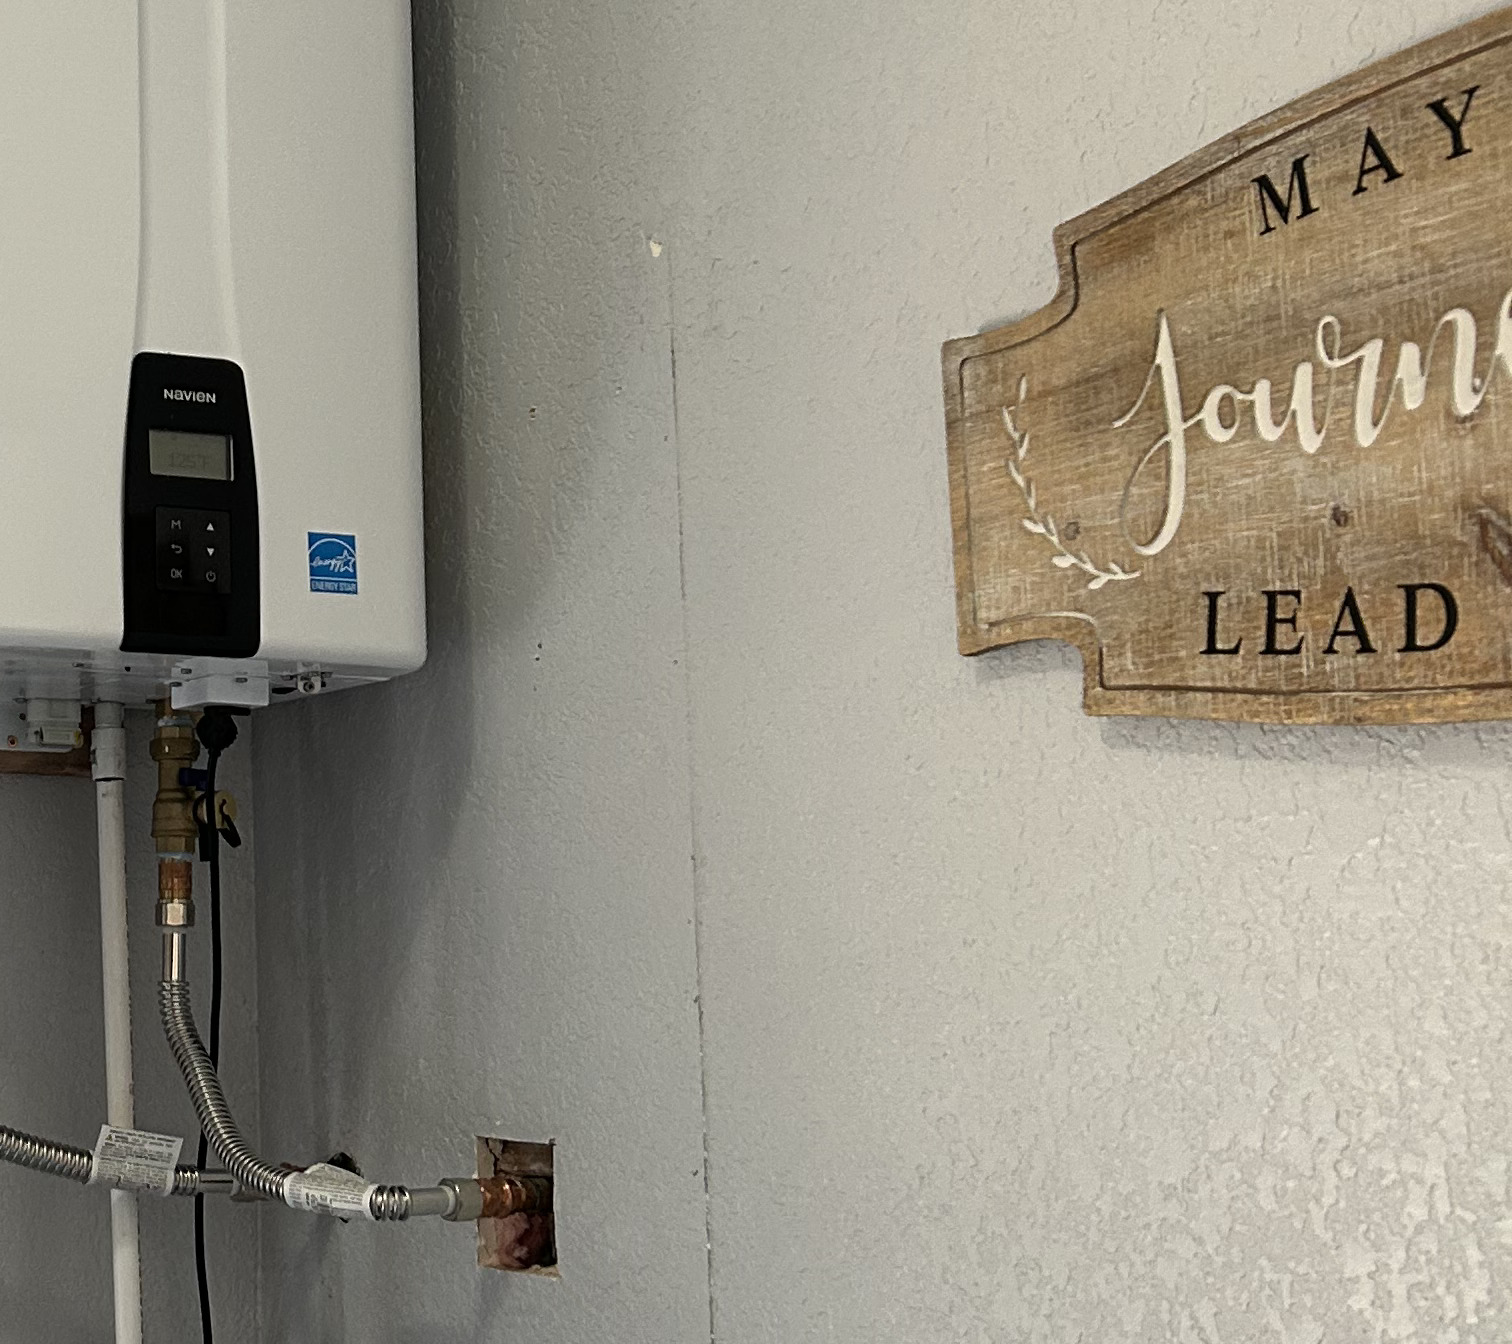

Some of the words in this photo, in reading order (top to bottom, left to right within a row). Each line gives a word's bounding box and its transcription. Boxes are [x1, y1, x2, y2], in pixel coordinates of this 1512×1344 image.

[1249, 86, 1481, 235] MAY
[1112, 294, 1512, 557] Journ
[171, 520, 181, 529] M
[171, 568, 182, 578] OK
[1199, 582, 1459, 656] LEAD
